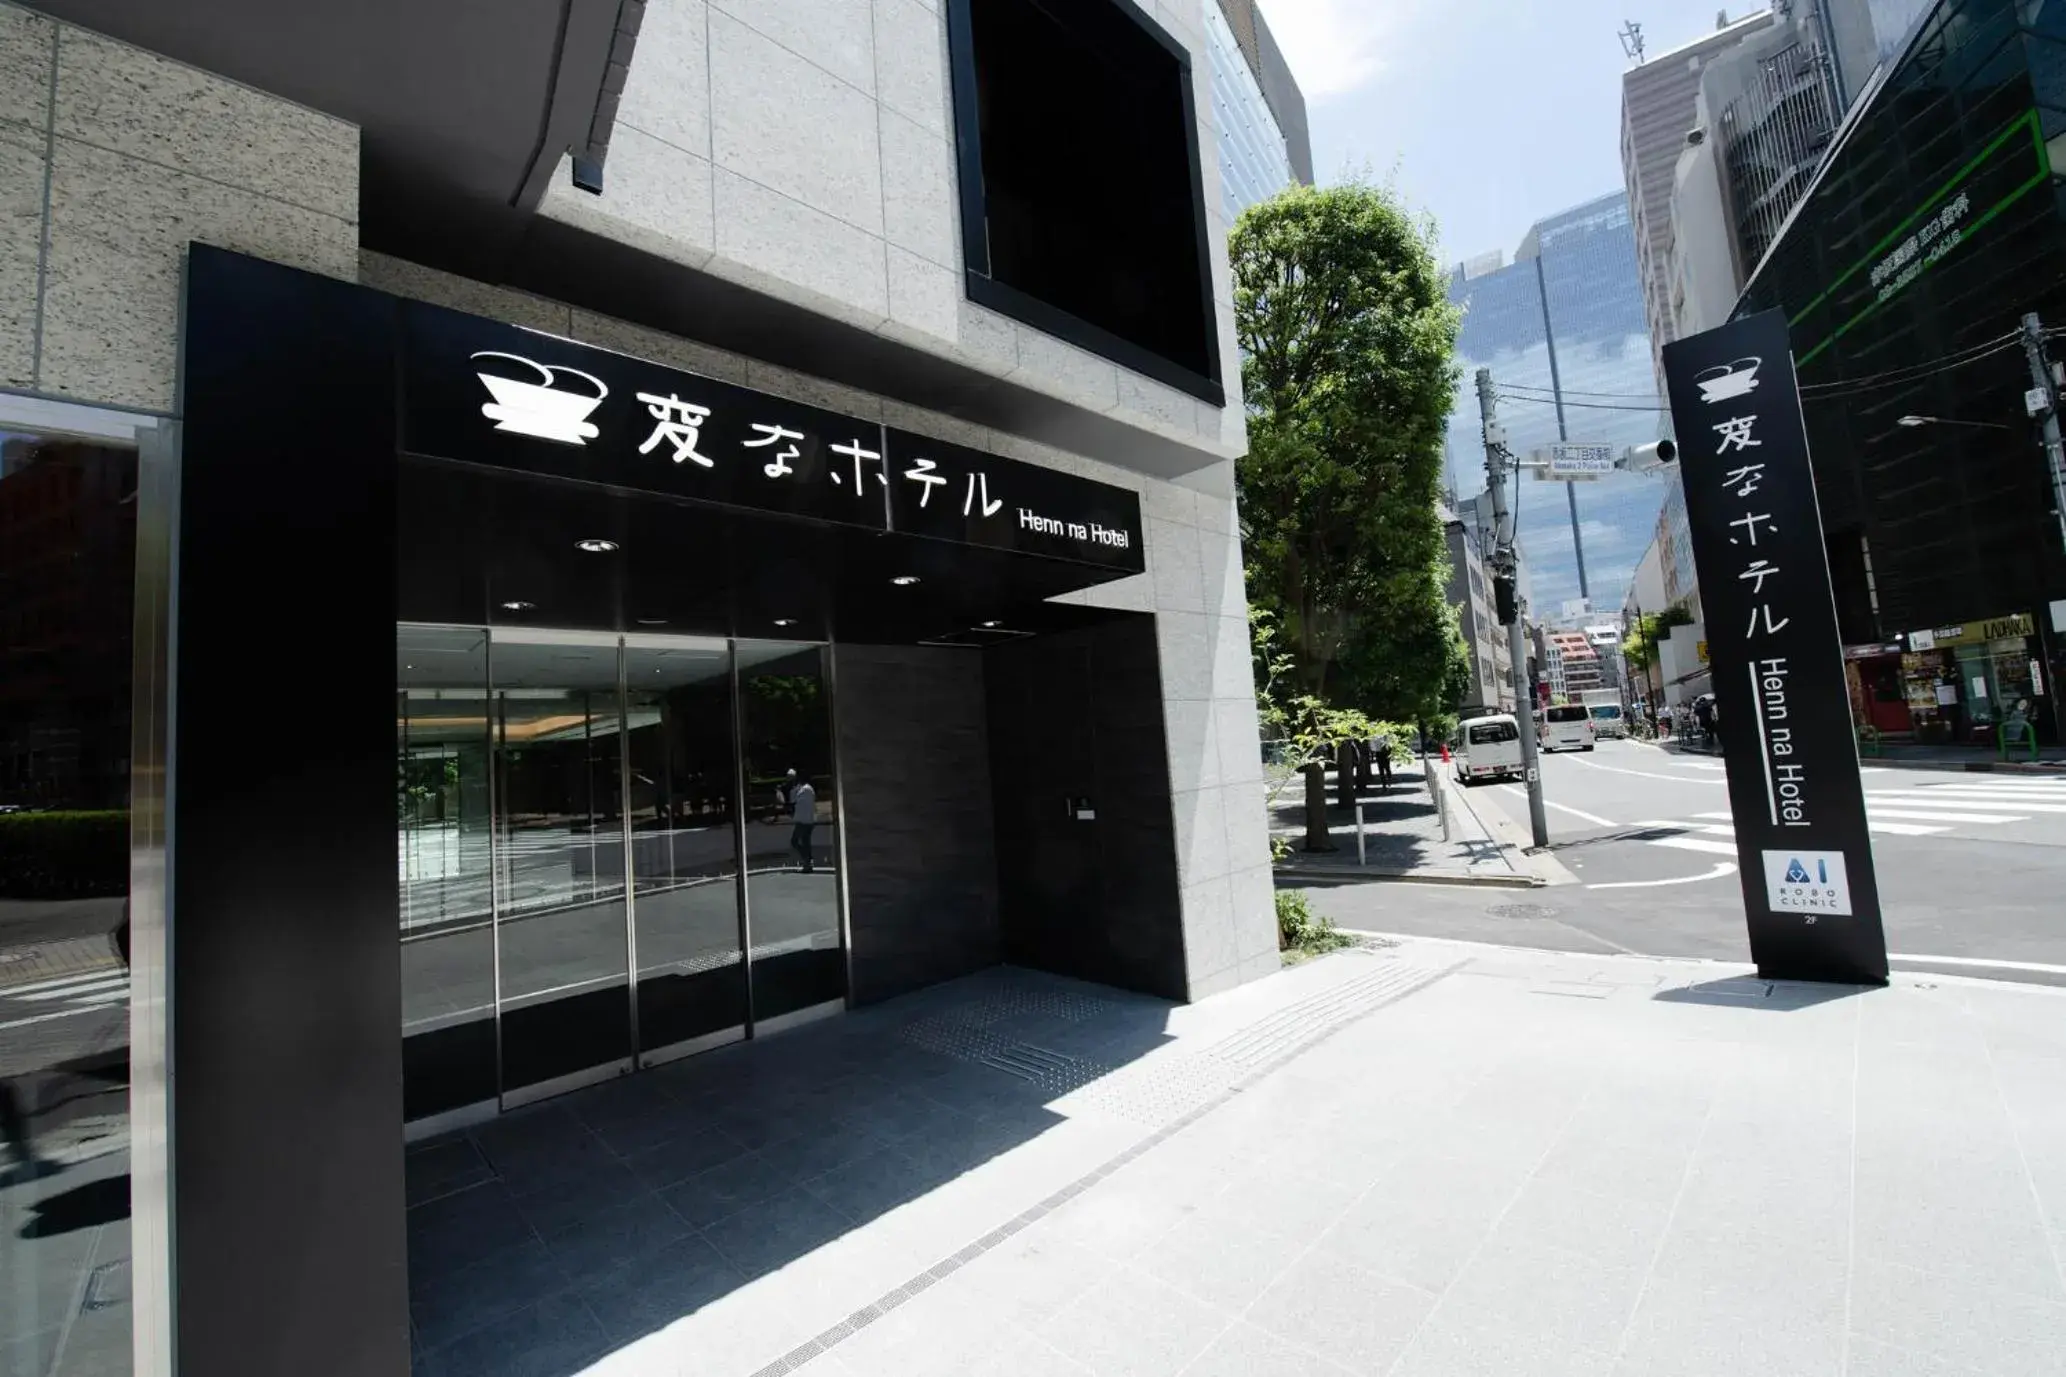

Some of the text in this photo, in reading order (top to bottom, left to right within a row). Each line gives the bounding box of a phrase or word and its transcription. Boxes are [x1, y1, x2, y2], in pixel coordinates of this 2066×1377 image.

[636, 391, 1003, 517] 変なホテル
[1019, 507, 1129, 548] Henn na Hotel
[1713, 415, 1789, 642] 変なホテル
[1761, 658, 1811, 826] Henn na Hotel
[1784, 857, 1829, 886] AI
[1780, 887, 1837, 898] ROBO
[1781, 897, 1838, 909] CLINIC
[1804, 915, 1818, 926] 2F
